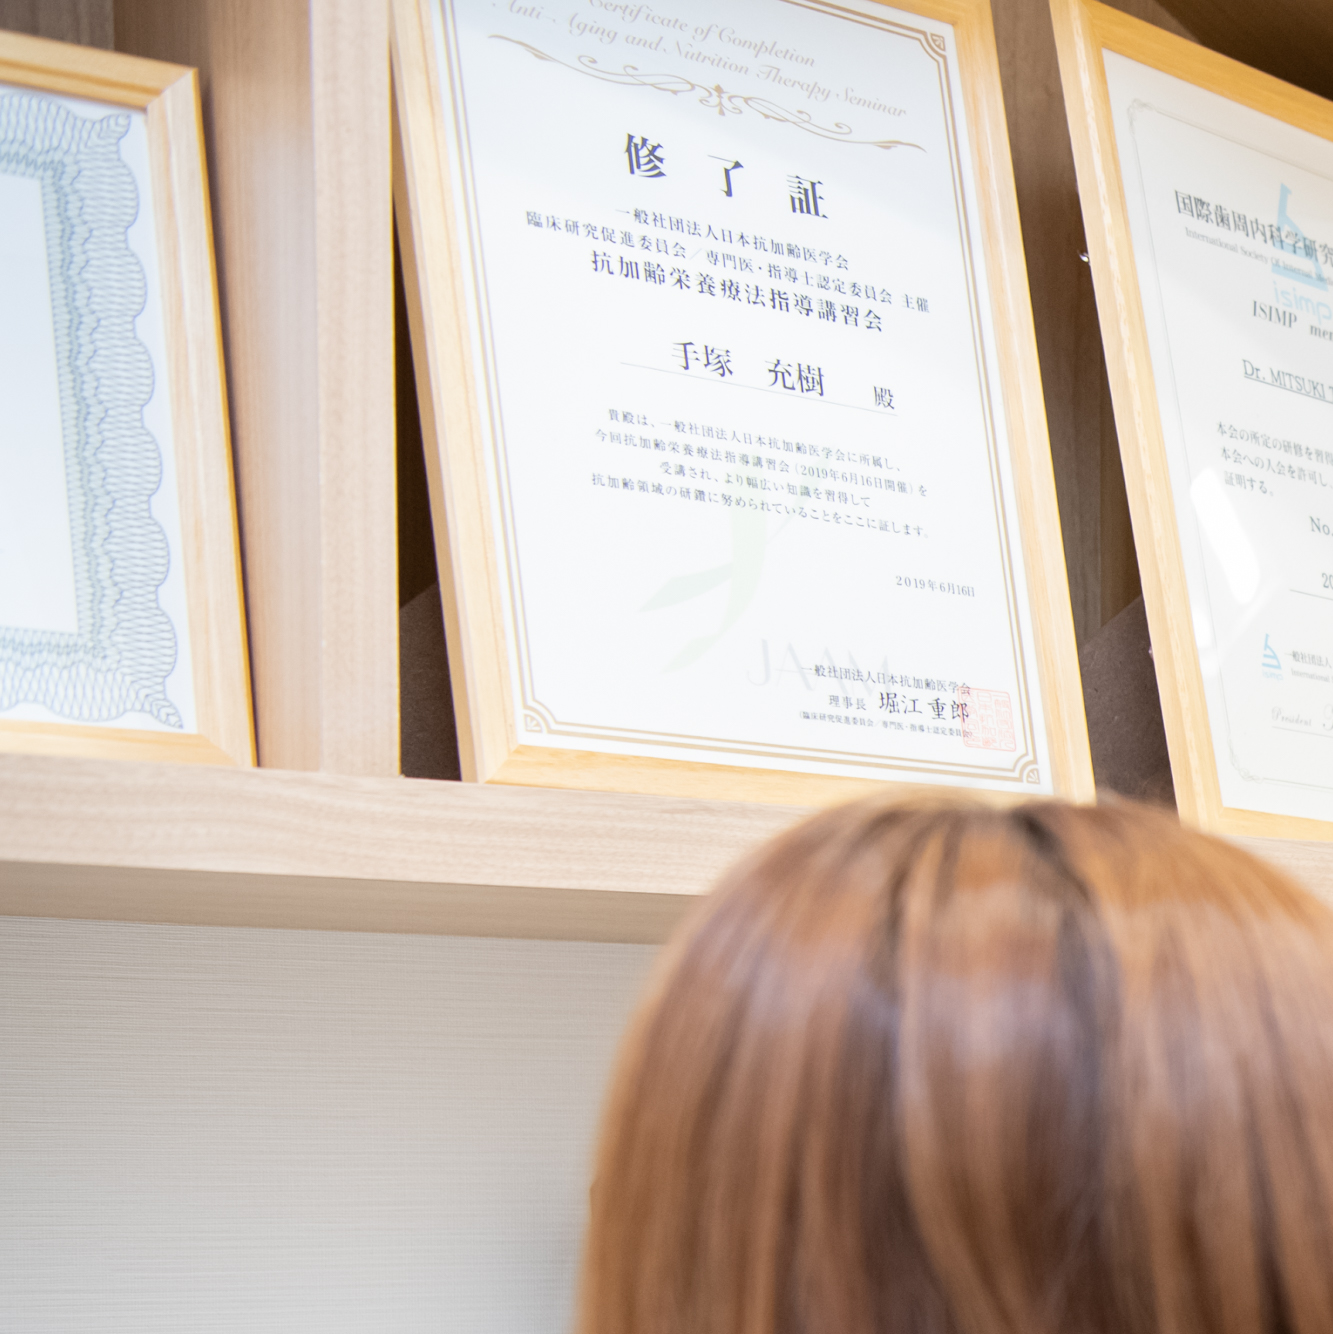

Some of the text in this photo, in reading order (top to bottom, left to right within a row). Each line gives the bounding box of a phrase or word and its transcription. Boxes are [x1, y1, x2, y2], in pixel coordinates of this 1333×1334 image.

[692, 24, 719, 42] of
[719, 27, 815, 67] Completion
[625, 35, 663, 52] and
[665, 39, 749, 75] Nutrition
[756, 64, 830, 102] Therapy
[836, 87, 907, 117] Seminar
[615, 207, 849, 270] 一般社団法人日本抗加齢医学会
[1185, 227, 1239, 253] International
[1240, 246, 1268, 264] Society
[592, 250, 883, 332] 抗加齢栄養療法指導講習会
[902, 293, 930, 314] 主催
[1272, 280, 1333, 324] isimp
[1253, 300, 1298, 329] ISIMP
[671, 341, 895, 410] 手塚 充樹 殿
[1242, 359, 1266, 381] Dr.
[1270, 367, 1326, 399] MITSUKI
[659, 461, 871, 508] 受講され、より幅広い知識を習得して
[1224, 470, 1274, 497] 証明する。
[895, 575, 975, 597] 2019年6月16日
[801, 664, 971, 696] 一般社団法人日本抗加齢医学会
[828, 691, 970, 723] 理事長 堀江 重郎
[1271, 706, 1312, 727] President
